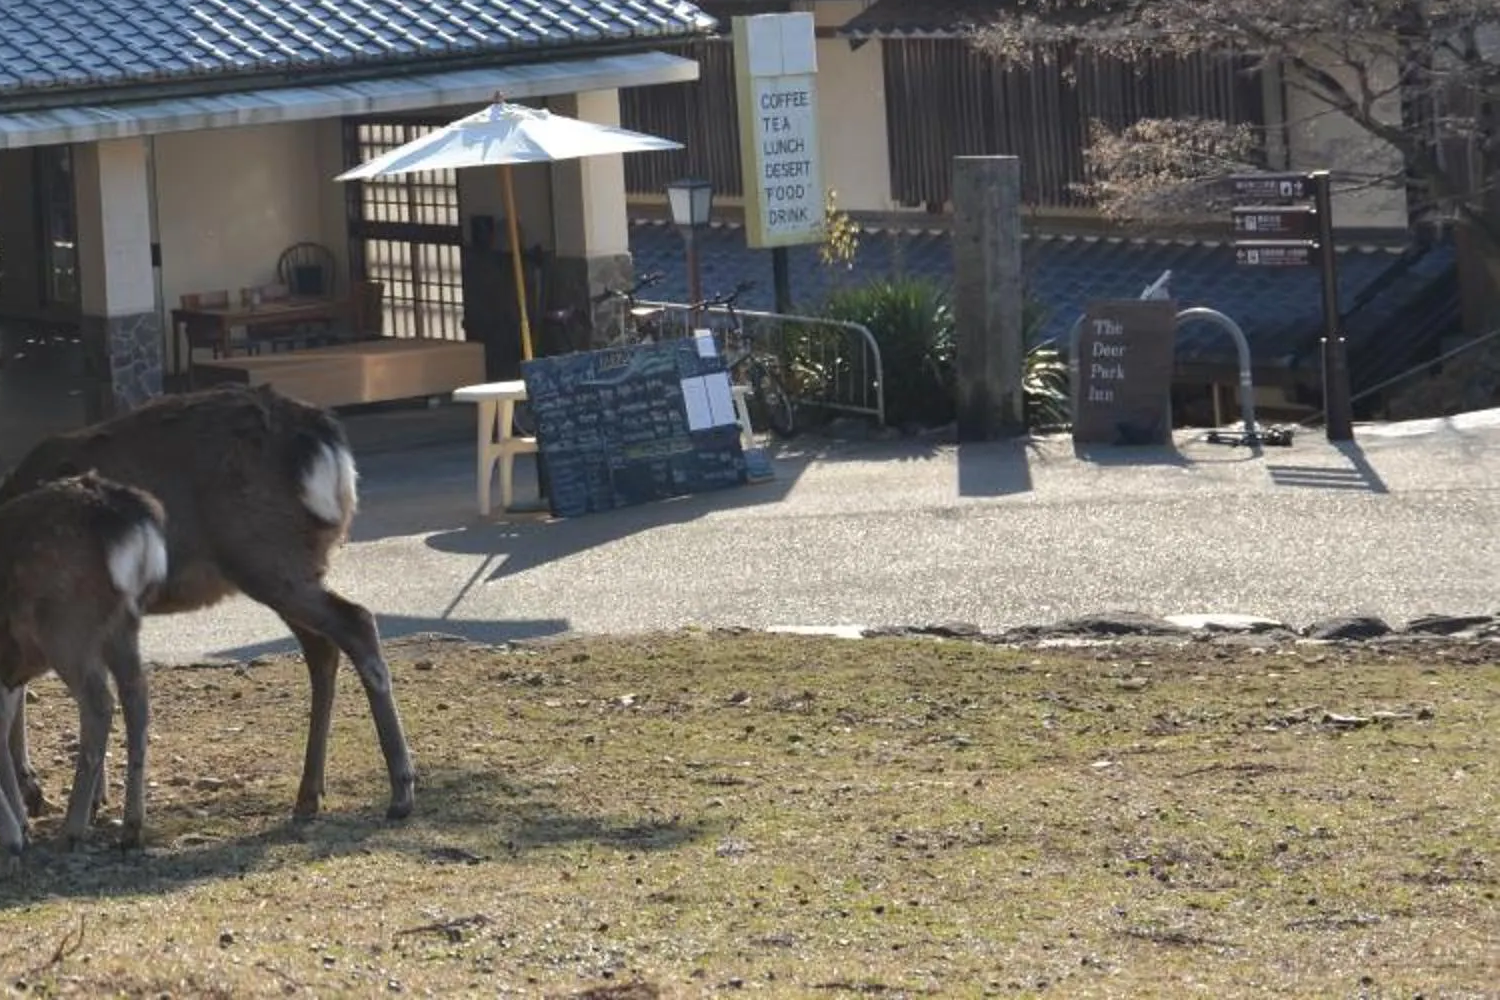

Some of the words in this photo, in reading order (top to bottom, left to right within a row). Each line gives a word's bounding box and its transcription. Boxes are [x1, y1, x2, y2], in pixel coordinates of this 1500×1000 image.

[761, 91, 810, 110] COFFEE
[762, 116, 792, 132] TEA
[763, 138, 805, 156] LUNCH
[765, 161, 811, 179] DESERT
[769, 207, 810, 226] DRINK
[1092, 319, 1124, 336] The
[1092, 341, 1127, 357] Deer
[1090, 363, 1125, 380] Park
[1088, 384, 1115, 402] Inn
